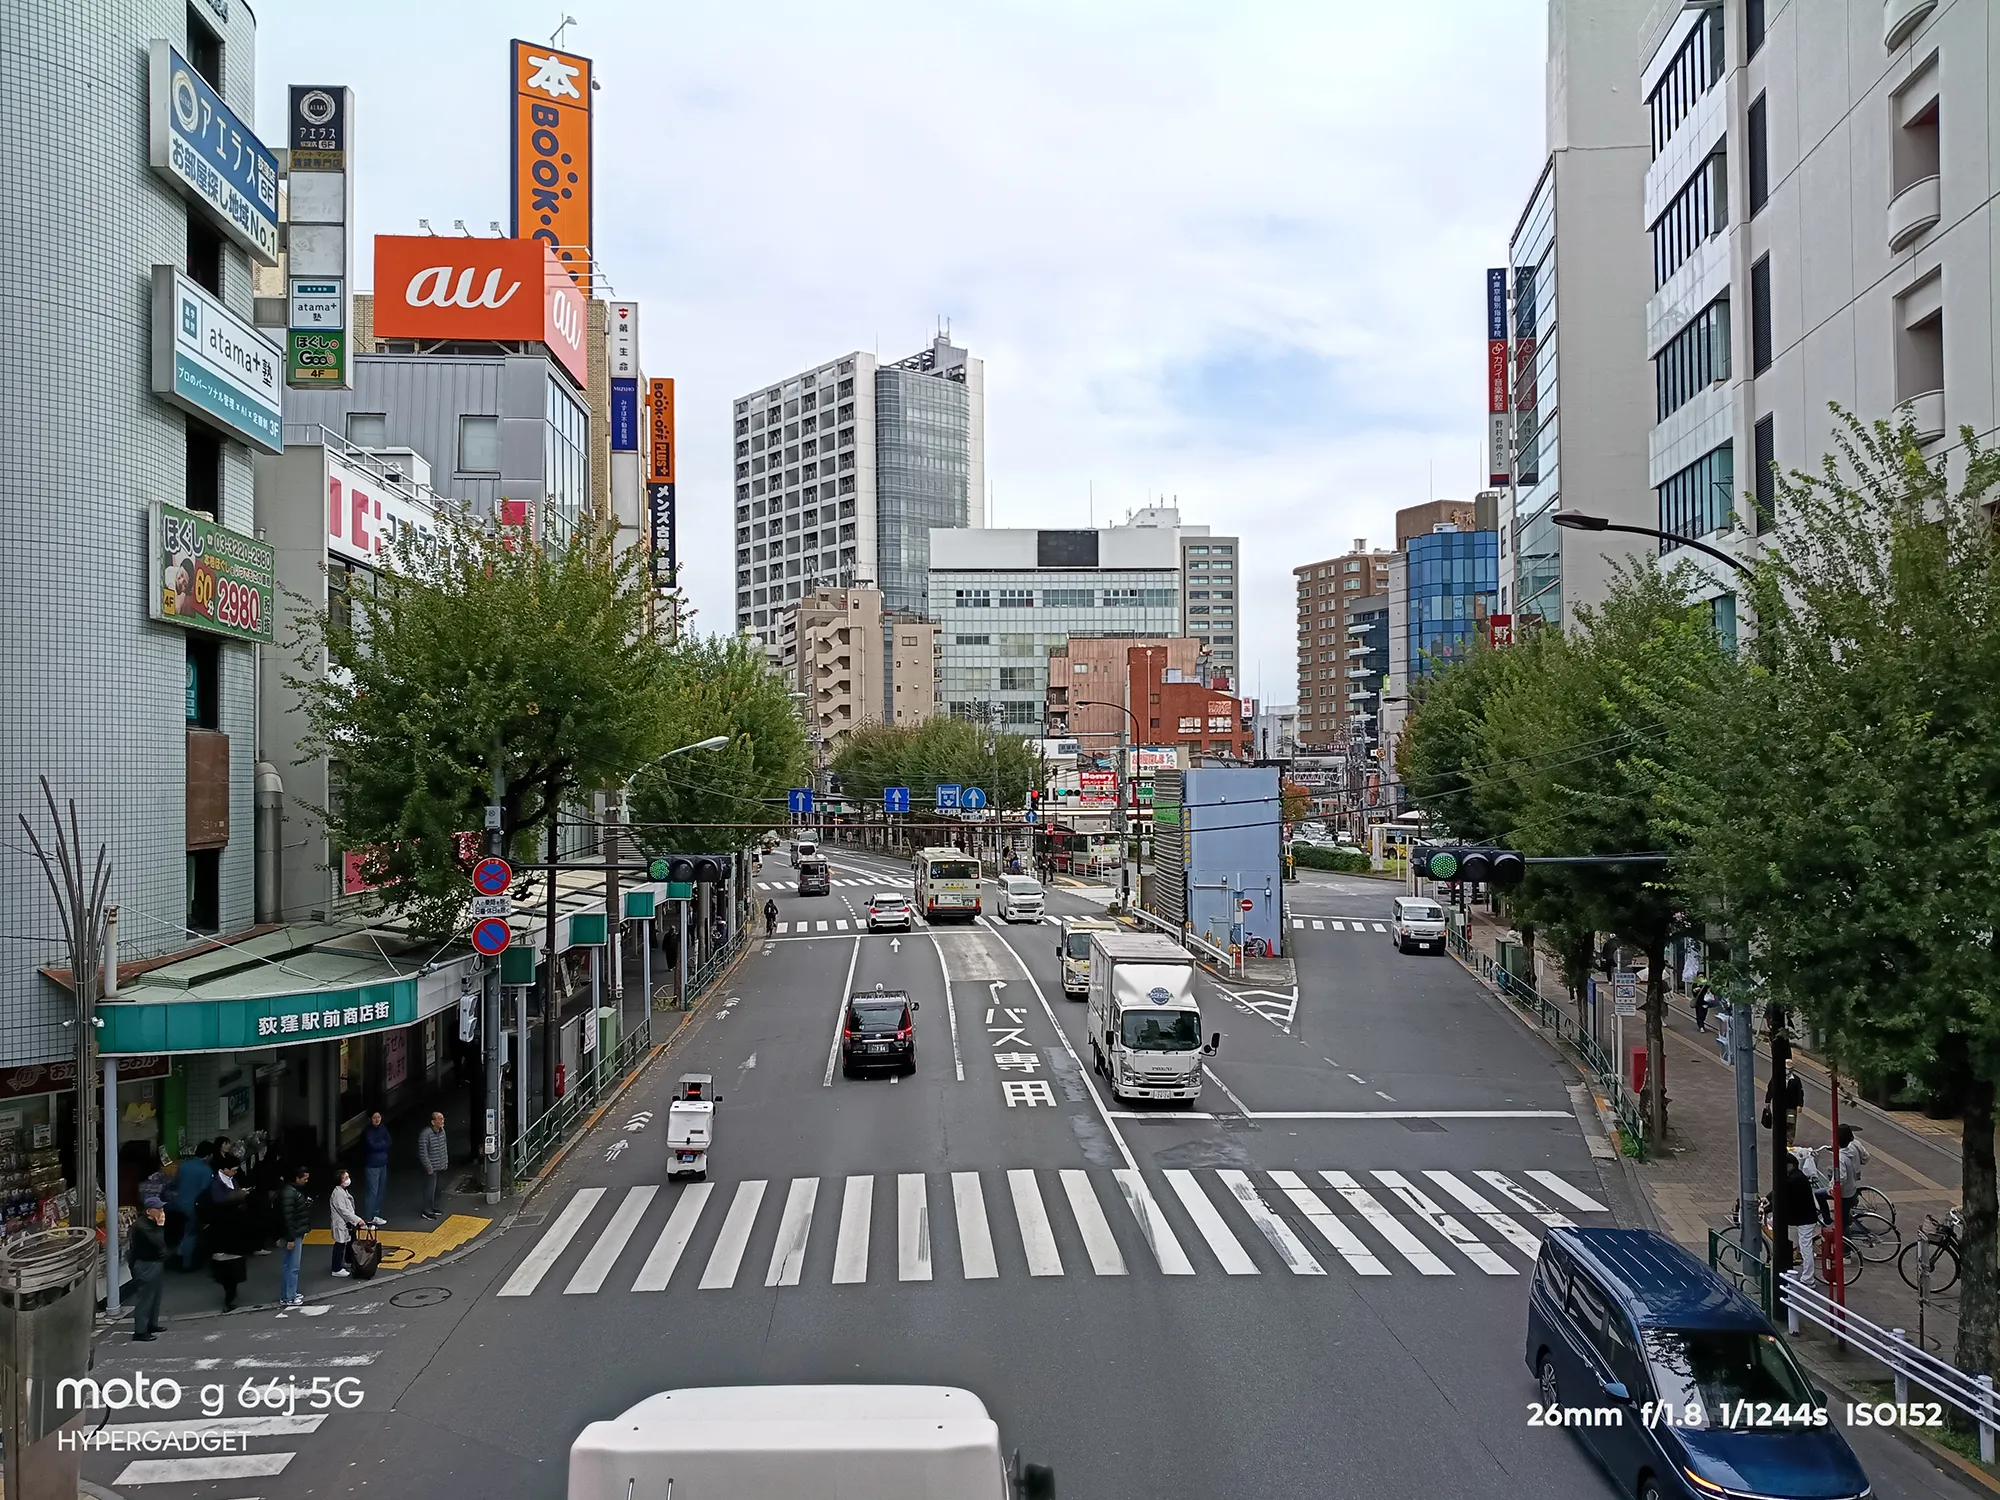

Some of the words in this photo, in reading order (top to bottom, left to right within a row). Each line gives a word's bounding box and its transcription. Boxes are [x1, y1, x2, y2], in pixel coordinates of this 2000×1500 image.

[527, 55, 580, 98] 本
[201, 97, 255, 189] アエラス
[300, 127, 336, 139] アエラス
[261, 179, 273, 202] 6F
[298, 303, 337, 311] atama+
[404, 266, 521, 309] au
[313, 313, 322, 321] 塾
[553, 289, 582, 350] au
[619, 324, 628, 371] 第一生命
[1494, 356, 1503, 410] カワイ音楽教室
[270, 420, 279, 437] 3F
[164, 515, 204, 557] ほぐし
[214, 532, 271, 570] 03-3220-2980
[165, 596, 174, 608] 4F
[258, 1001, 390, 1036] 荻窪駅前商店街
[985, 1008, 1057, 1107] バス専用
